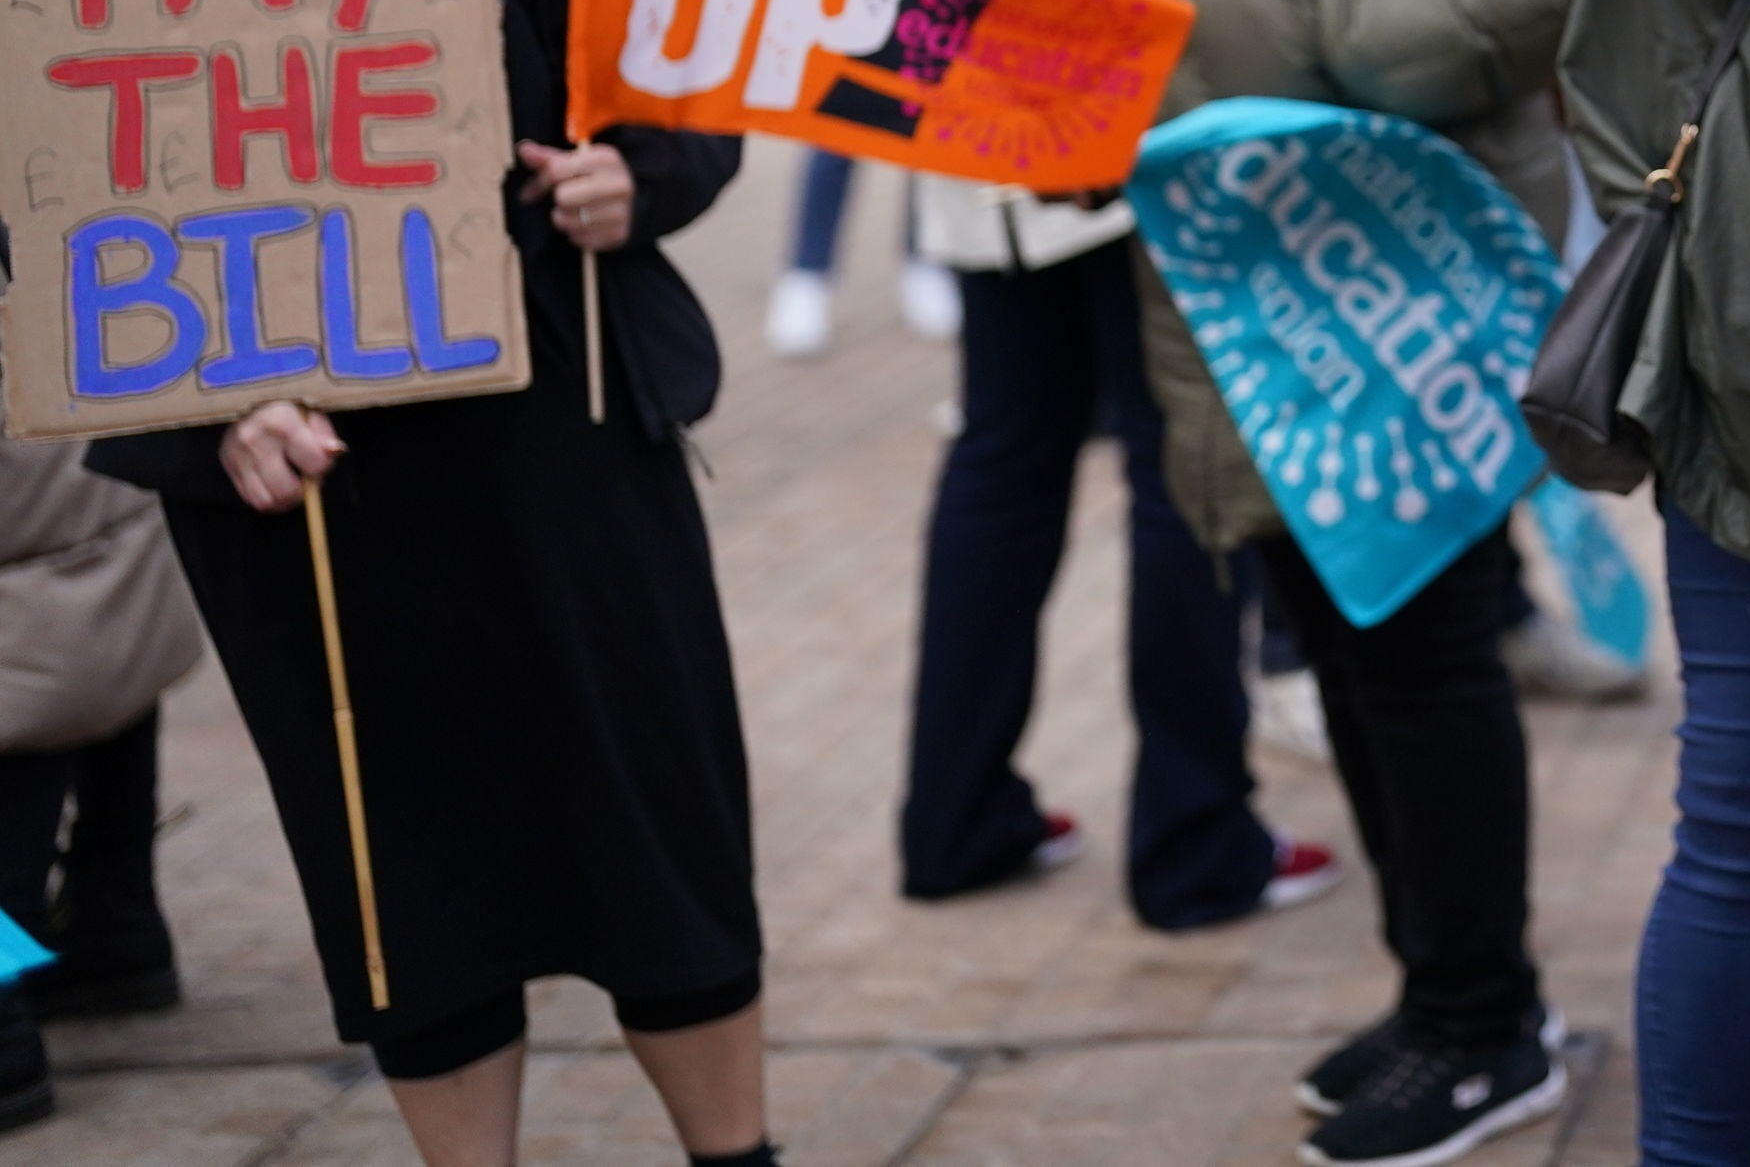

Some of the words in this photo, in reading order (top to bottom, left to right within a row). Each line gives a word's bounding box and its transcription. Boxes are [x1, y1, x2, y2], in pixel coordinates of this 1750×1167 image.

[47, 41, 439, 191] THE
[67, 205, 500, 398] BILL
[1320, 136, 1503, 329] national
